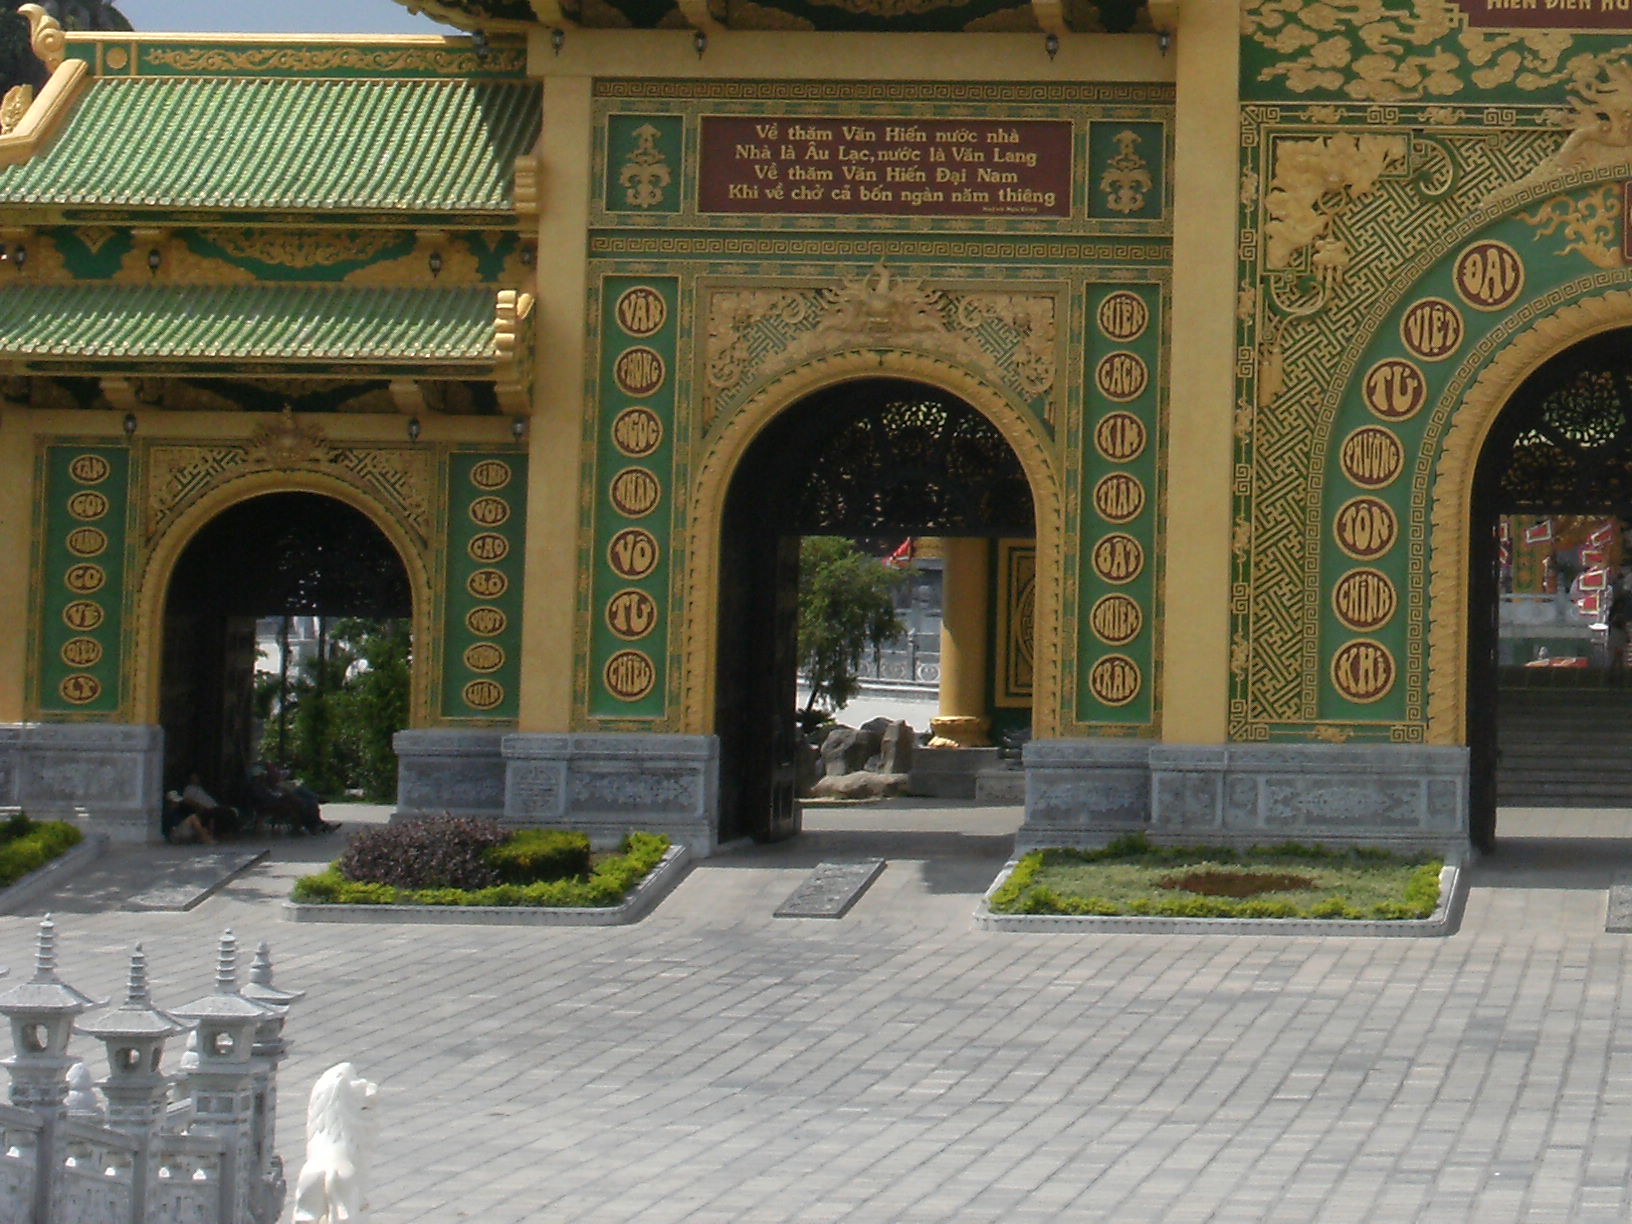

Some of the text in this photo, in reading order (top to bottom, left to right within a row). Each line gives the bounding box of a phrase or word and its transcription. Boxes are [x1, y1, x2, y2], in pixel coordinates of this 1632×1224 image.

[755, 122, 1020, 143] Về thăm Văn Hiến nước nhà
[735, 144, 771, 159] Nhà
[780, 144, 795, 160] là
[804, 141, 829, 160] Âu
[877, 146, 921, 161] nước
[930, 147, 945, 162] là
[952, 147, 984, 162] Văn
[993, 148, 1037, 167] Lang
[754, 161, 1018, 186] Về thăm Văn Hiến Đại Nam
[728, 184, 759, 199] Khi
[765, 182, 785, 200] về
[859, 184, 893, 201] bốn
[901, 187, 944, 206] ngàn
[951, 188, 989, 202] năm
[998, 187, 1056, 207] thiêng
[1460, 249, 1516, 303] ĐẠI
[622, 292, 662, 331] VĂN
[1407, 305, 1457, 353] VIỆT
[1369, 365, 1419, 413] TỨ
[1100, 418, 1140, 457] KIM
[1341, 504, 1391, 552] TÔN
[614, 534, 654, 573] VÔ
[1338, 576, 1388, 624] CHÍNH
[1338, 646, 1388, 694] KHÍ
